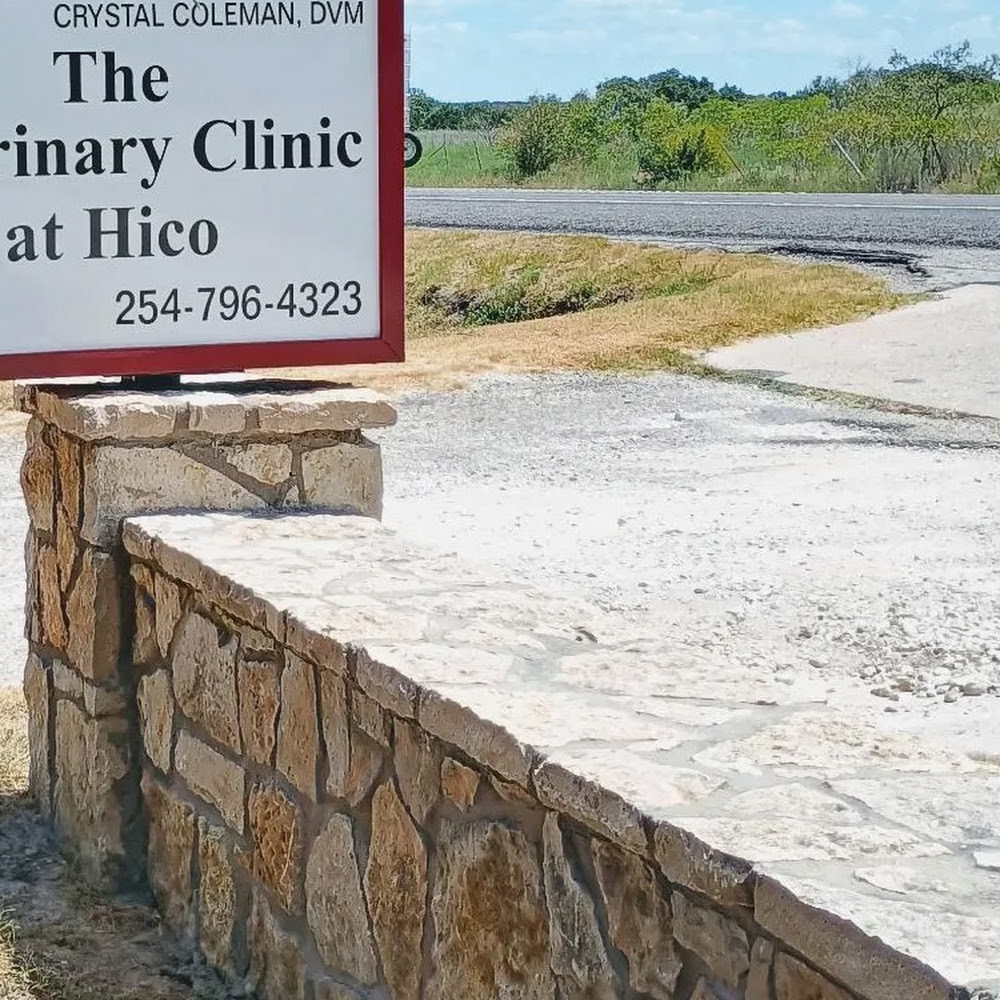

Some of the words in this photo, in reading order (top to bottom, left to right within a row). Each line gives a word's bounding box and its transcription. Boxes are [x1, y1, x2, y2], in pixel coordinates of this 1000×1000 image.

[53, 3, 165, 28] CRYSTAL
[172, 1, 301, 28] COLEMAN,
[310, 1, 364, 25] DVM
[53, 50, 169, 104] The
[192, 117, 363, 173] Clinic
[6, 212, 64, 262] at
[83, 205, 219, 260] Hico
[115, 280, 362, 325] 254-796-4323
